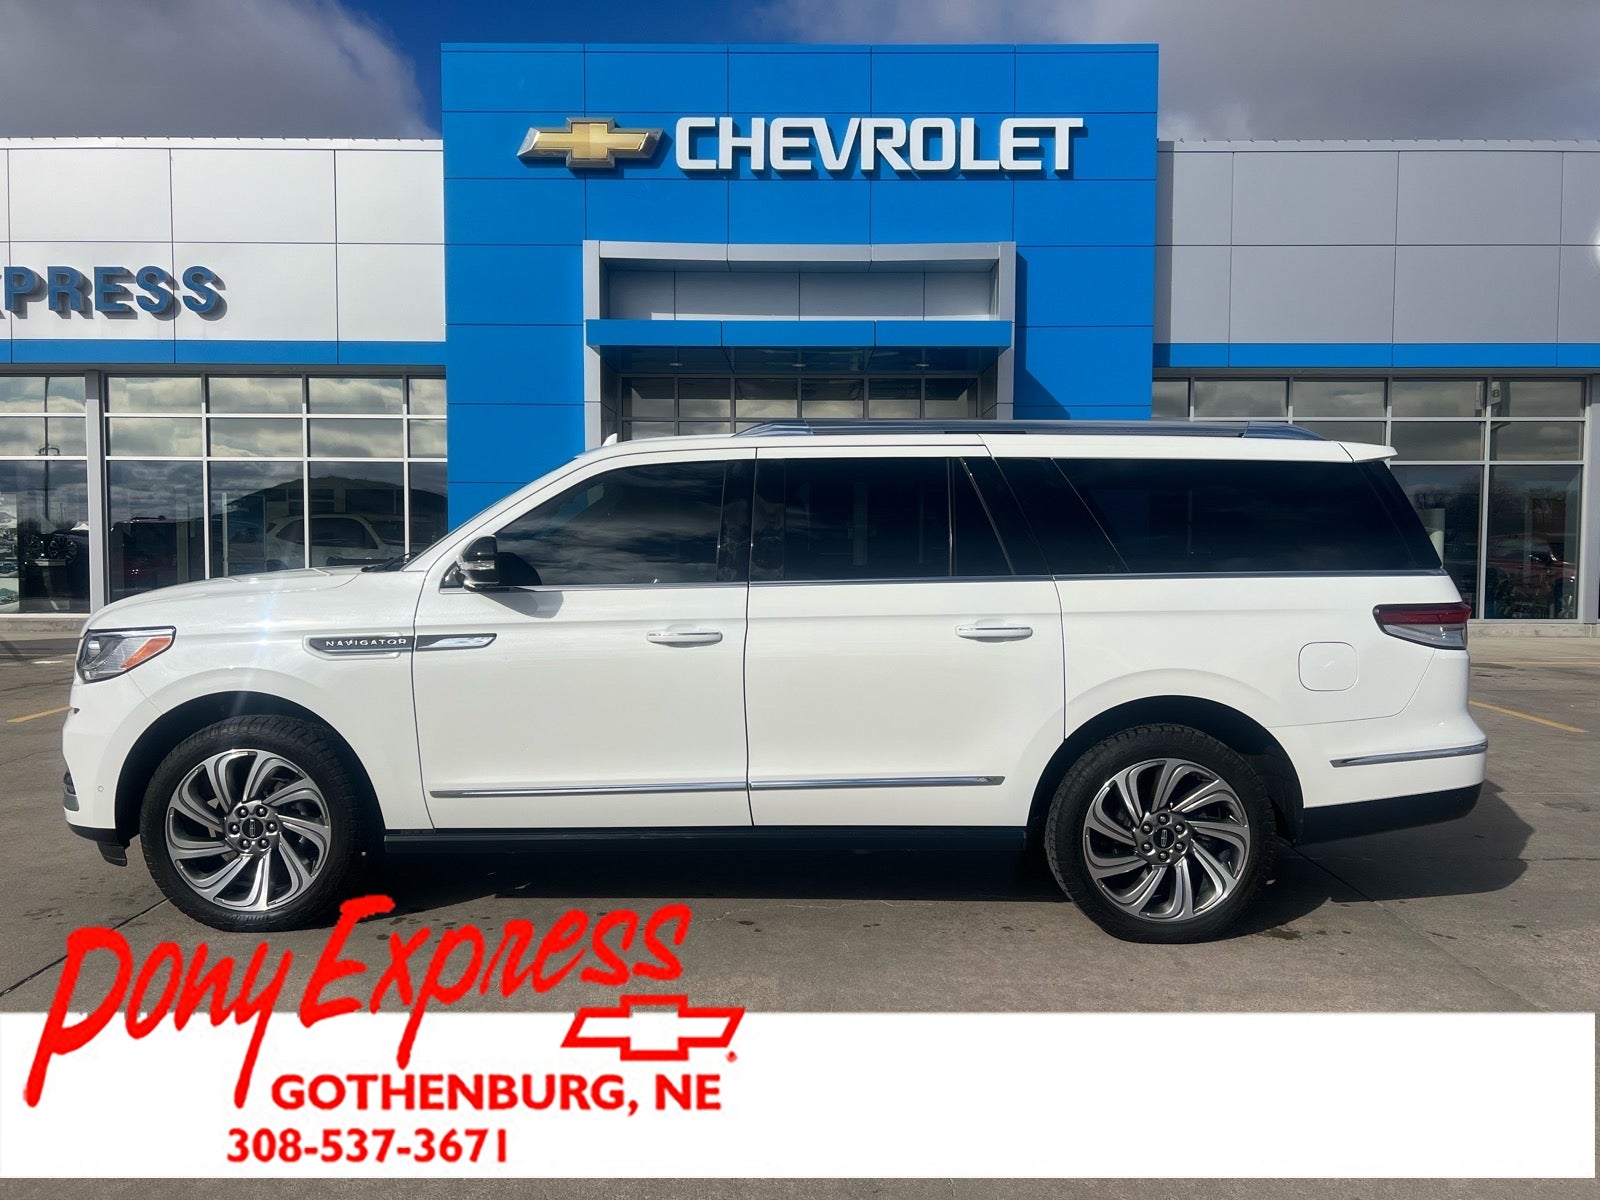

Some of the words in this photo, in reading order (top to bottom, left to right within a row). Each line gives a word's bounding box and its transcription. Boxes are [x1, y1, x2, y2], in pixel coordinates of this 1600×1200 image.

[675, 116, 1084, 172] CHEVROLET
[0, 265, 218, 314] PRESS
[325, 638, 408, 647] NAVIGATOR
